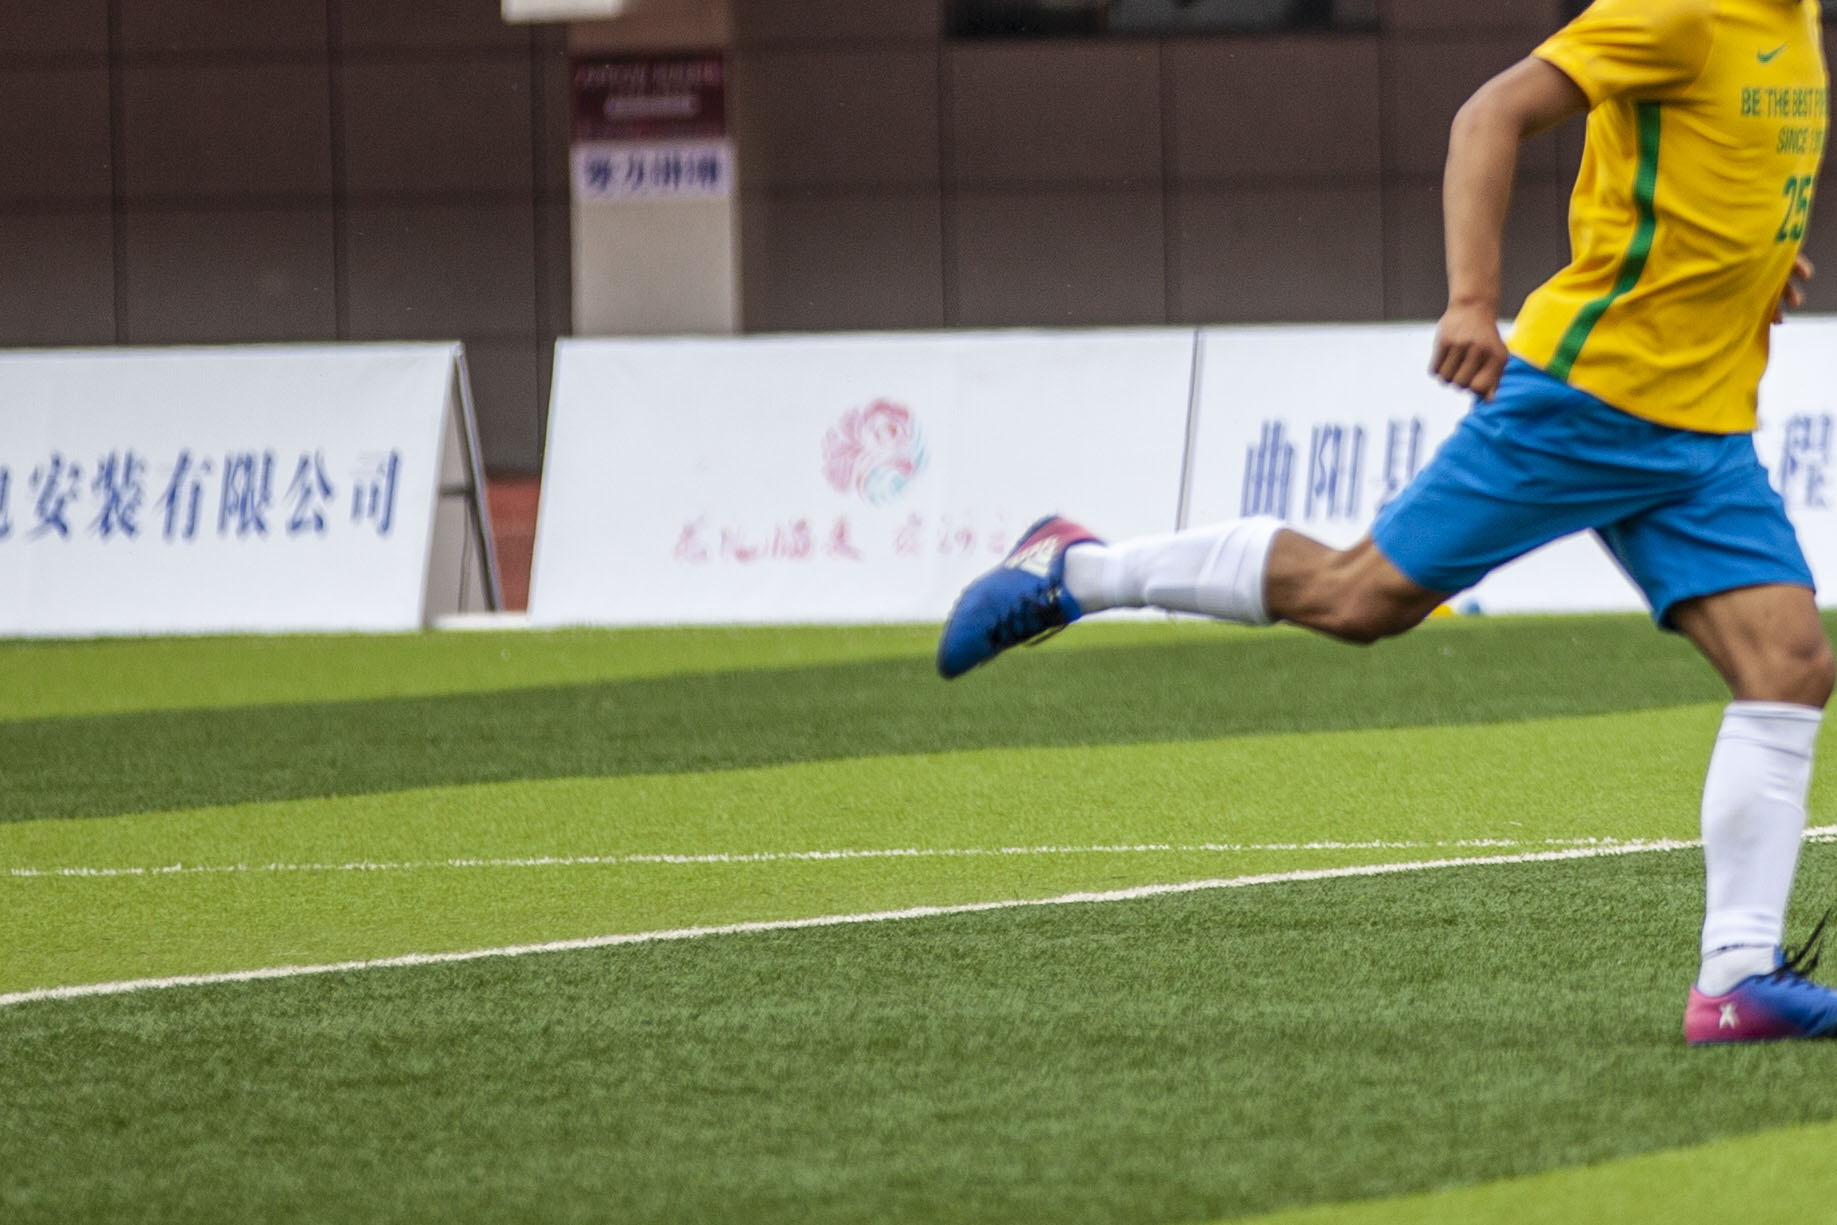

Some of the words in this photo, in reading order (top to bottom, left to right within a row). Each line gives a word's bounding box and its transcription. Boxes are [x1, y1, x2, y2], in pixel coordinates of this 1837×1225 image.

[1741, 87, 1760, 117] BE
[1766, 87, 1789, 118] THE
[1792, 87, 1813, 118] BEST
[1776, 126, 1808, 154] SINCE
